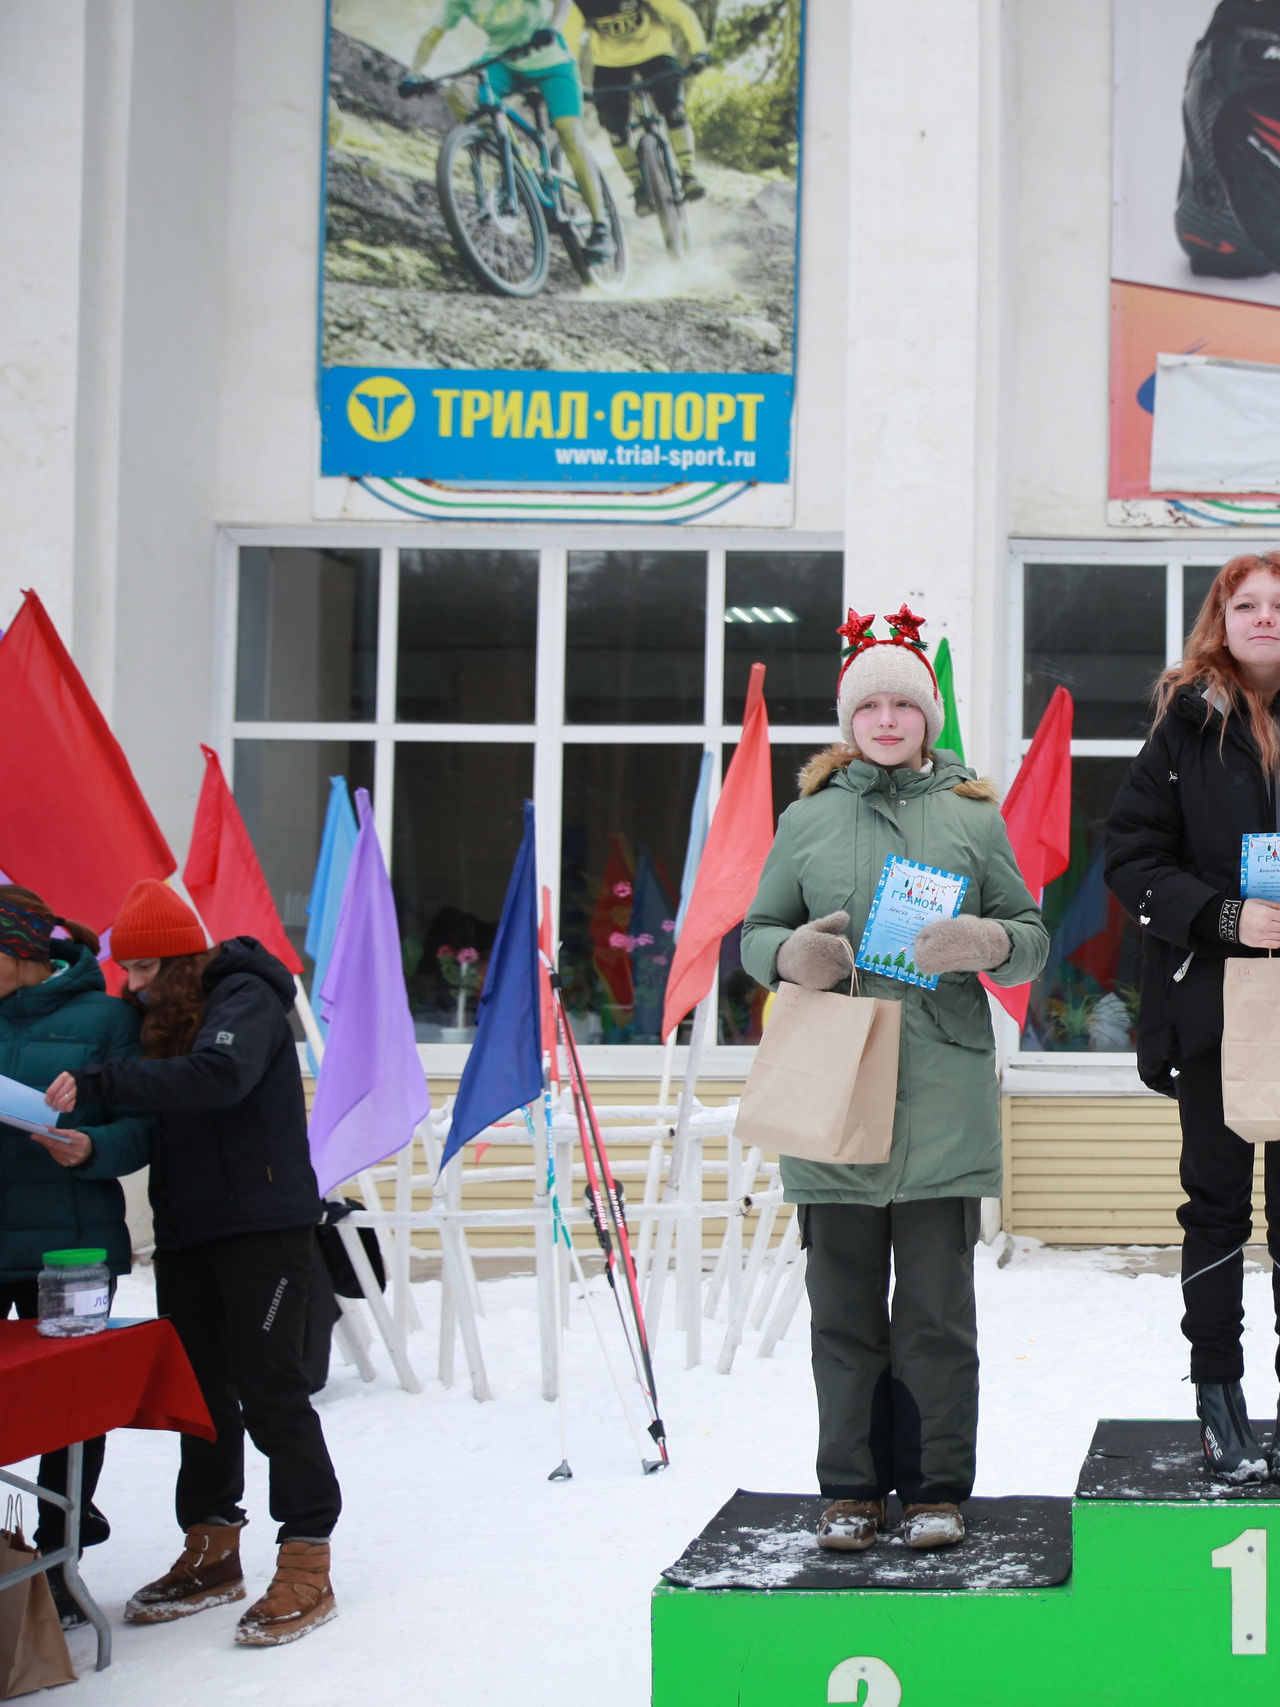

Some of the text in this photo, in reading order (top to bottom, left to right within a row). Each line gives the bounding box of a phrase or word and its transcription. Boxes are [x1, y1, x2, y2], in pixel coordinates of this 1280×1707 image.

[554, 444, 756, 471] www.trial-sport.ru
[891, 890, 943, 913] ГРАМОТА
[593, 1190, 609, 1230] NORDWAY
[609, 1188, 625, 1227] NORDWAY
[262, 1277, 288, 1332] noname
[1205, 1425, 1223, 1461] SPINE
[1211, 1528, 1267, 1655] 1
